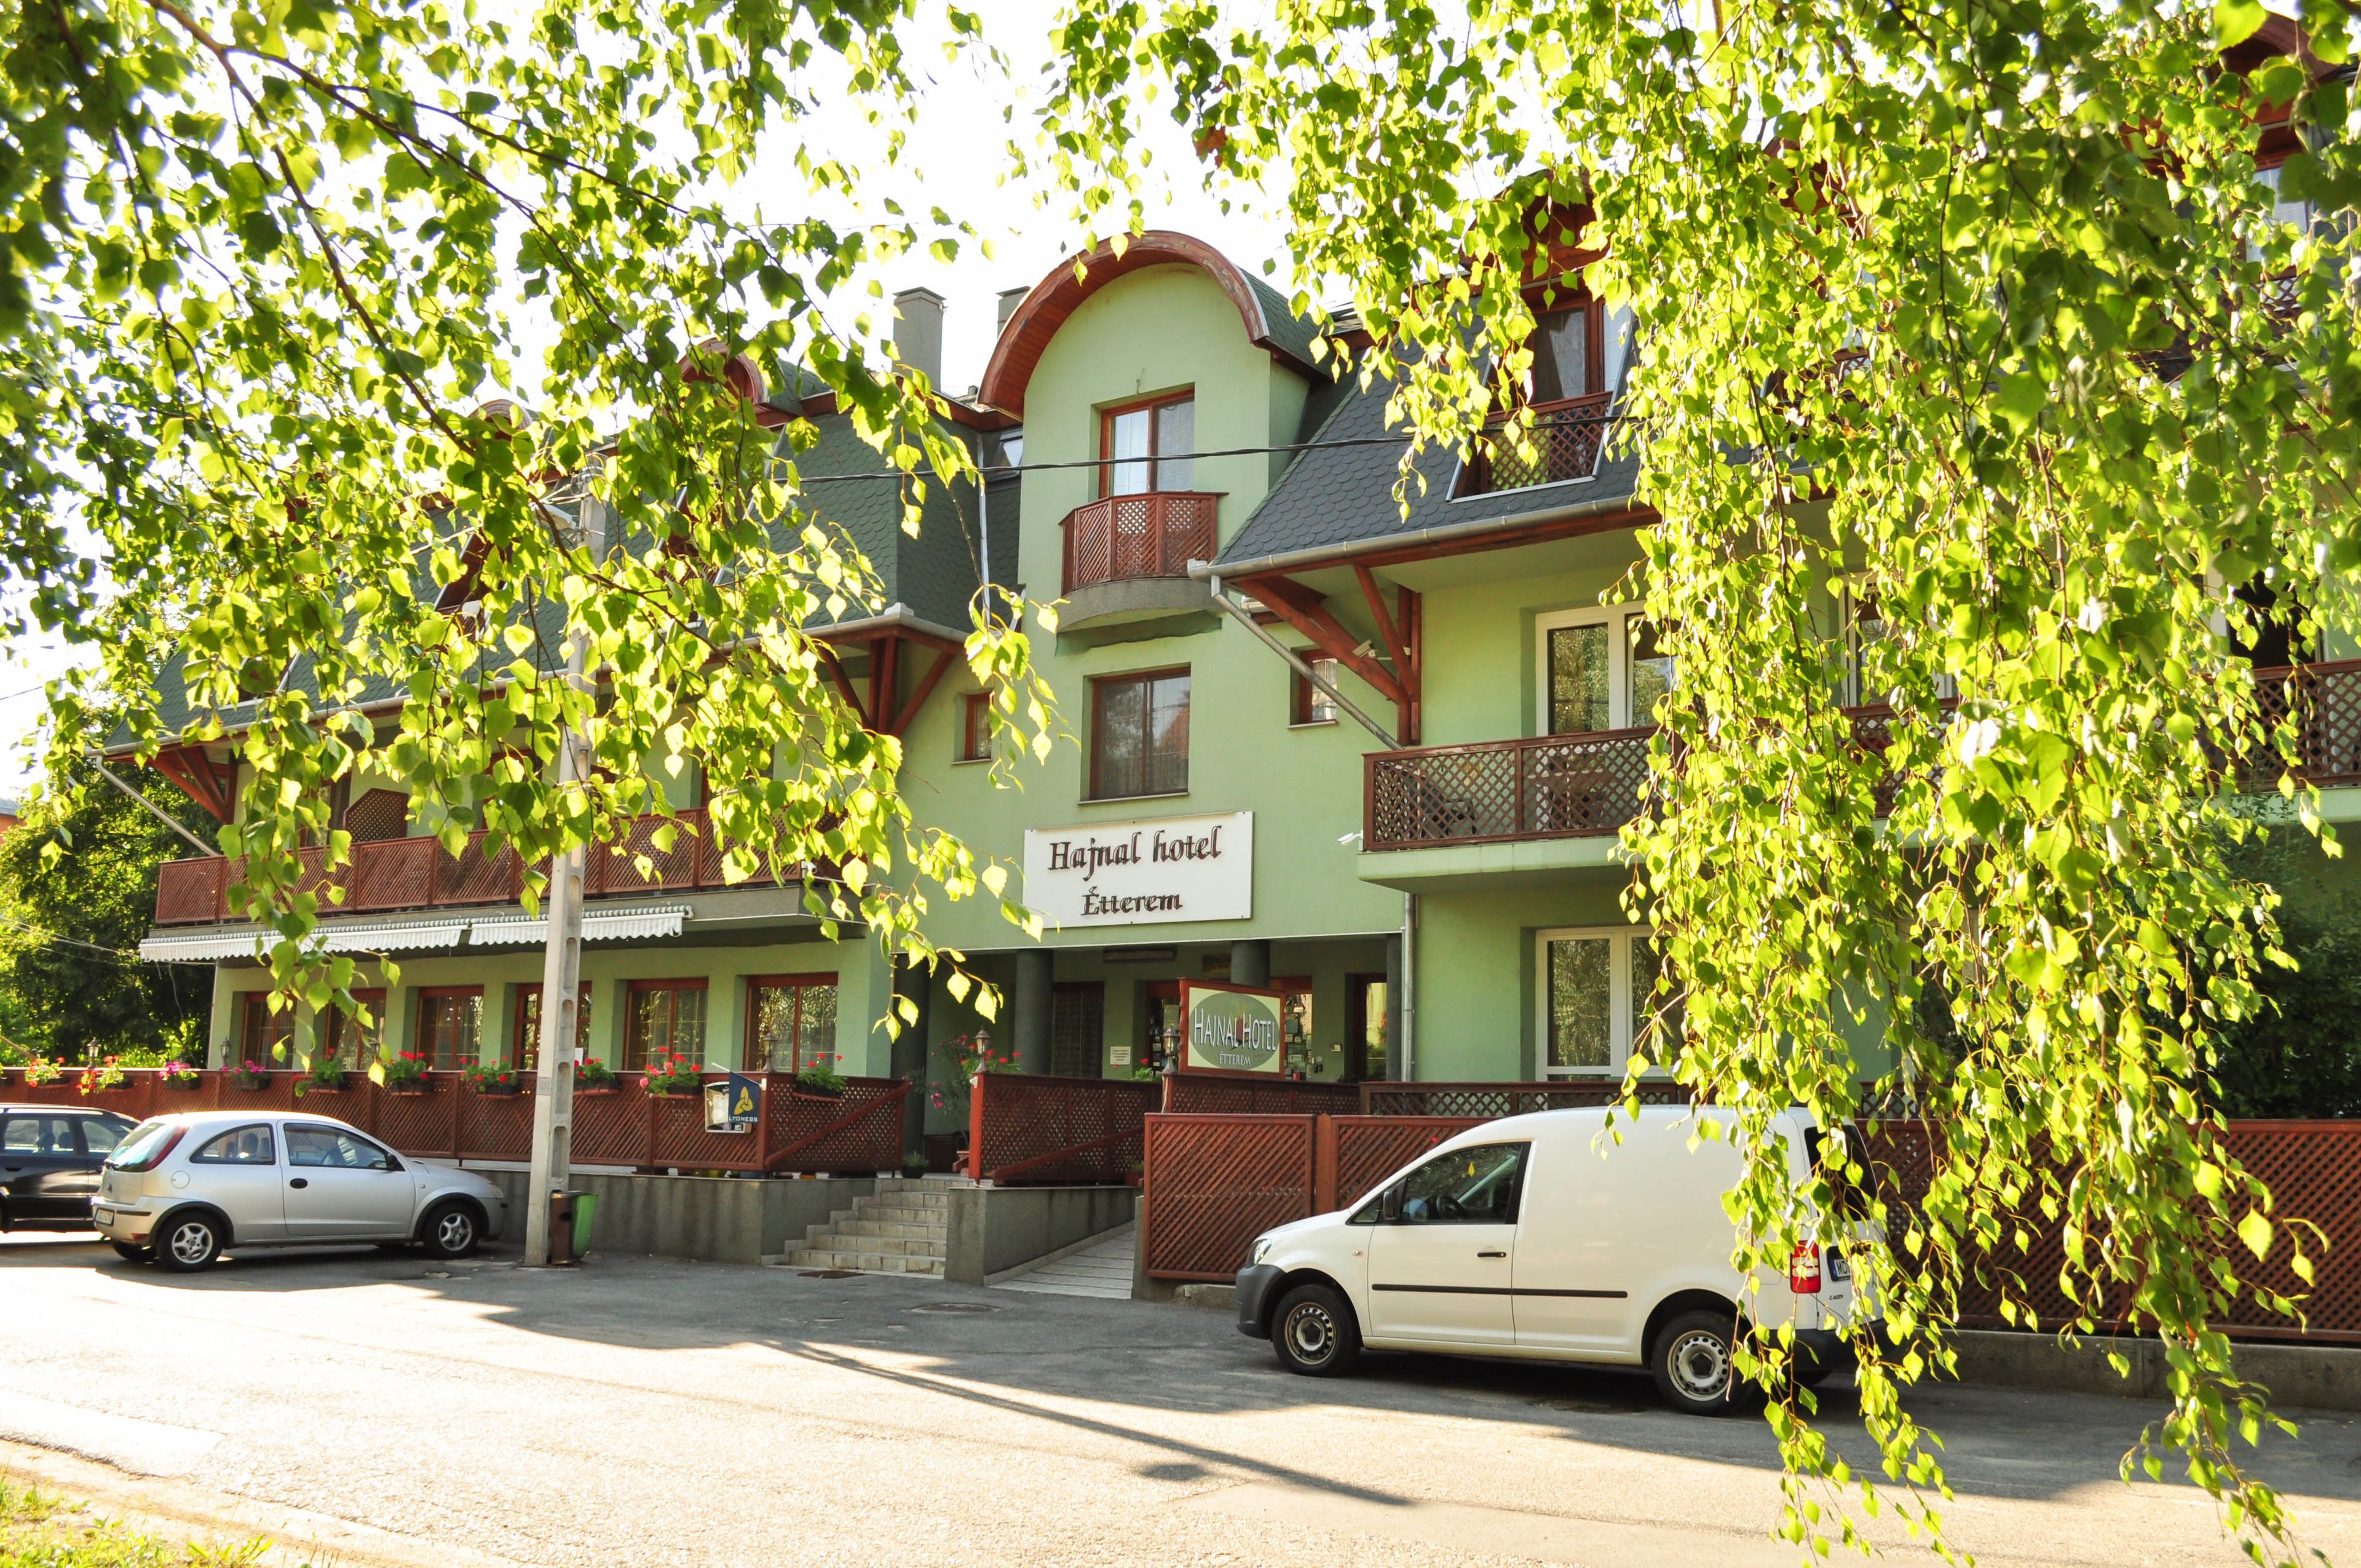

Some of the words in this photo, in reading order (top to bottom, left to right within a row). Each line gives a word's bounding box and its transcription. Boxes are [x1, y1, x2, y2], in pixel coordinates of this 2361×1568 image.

[1048, 831, 1142, 881] Hajnal
[1152, 825, 1222, 863] hotel
[1080, 885, 1183, 916] Étterem
[1193, 1007, 1238, 1048] HAJNAL
[1242, 1012, 1276, 1051] HOTEL
[1219, 1051, 1251, 1066] ÉTTEREM
